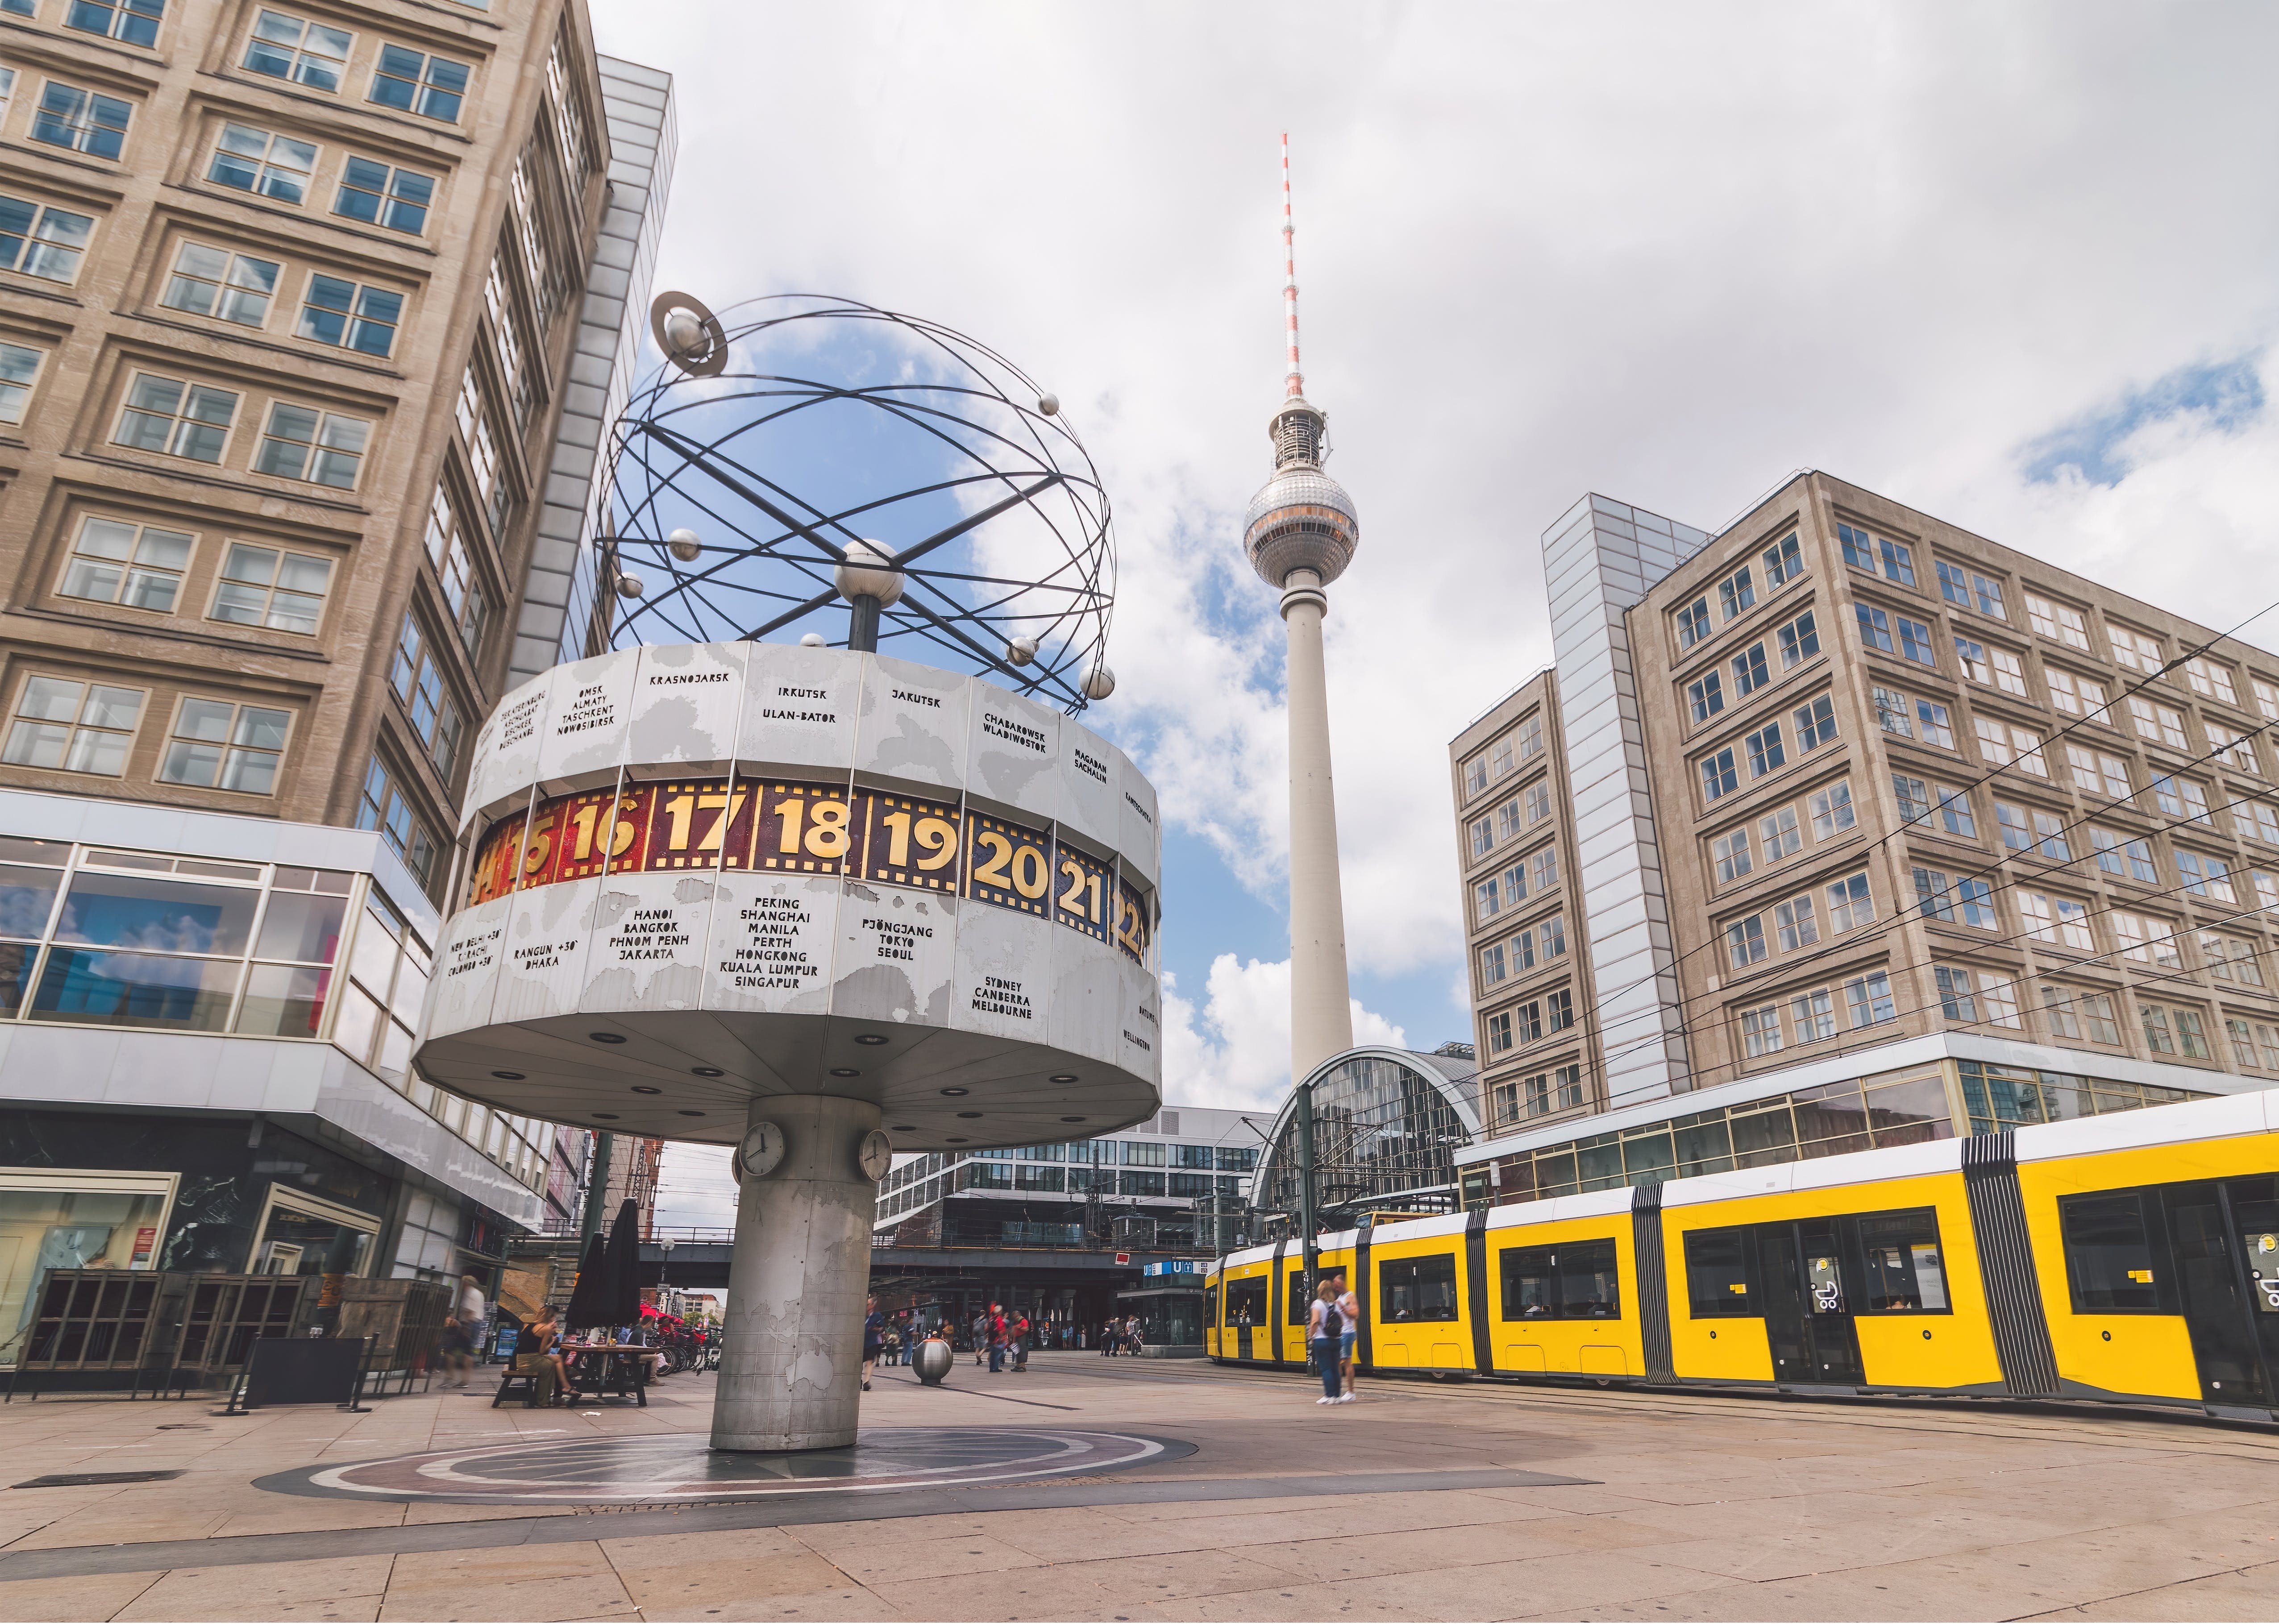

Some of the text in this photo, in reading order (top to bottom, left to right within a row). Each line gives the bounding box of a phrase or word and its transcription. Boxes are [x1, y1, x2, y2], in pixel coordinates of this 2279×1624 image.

[650, 673, 729, 685] KRASNOJARSK
[579, 685, 603, 698] OMSK
[778, 687, 827, 699] IRKUTSK
[892, 689, 941, 708] JAKUTSK
[572, 695, 607, 710] ALMATY
[563, 705, 614, 723] TASCHKENT
[763, 709, 836, 723] ULAN-BATOR
[557, 716, 615, 735] NOWOSIBIRSK
[984, 713, 1045, 743] CHABAROWSK
[983, 723, 1046, 754] WLADIWOSTOK
[1075, 748, 1106, 774] MAGADAN
[1074, 759, 1106, 784] SACHALIN
[1125, 792, 1152, 825] KAMTSCHATKA
[573, 799, 638, 860] 16
[665, 794, 746, 850] 17
[775, 799, 851, 858] 18
[509, 816, 554, 880] 15
[883, 811, 958, 870] 19
[974, 831, 1048, 899] 20
[1059, 860, 1101, 924] 21
[755, 897, 799, 909] PEKING
[634, 909, 673, 920] HANOI
[740, 910, 810, 922] SHANGHAI
[1111, 889, 1139, 955] 22
[624, 922, 678, 934] BANGKOK
[749, 923, 799, 935] MANILA
[862, 919, 932, 938] PJÖNGJANG
[466, 934, 486, 948] DELHI
[610, 935, 689, 947] PHNOM PENH
[753, 937, 792, 948] PERTH
[880, 934, 914, 948] TOKYO
[514, 944, 553, 959] RANGUN
[619, 949, 674, 960] JAKARTA
[736, 949, 807, 962] HONGKONG
[877, 947, 914, 960] SEOUL
[449, 960, 476, 976] COLOMBO
[526, 956, 559, 970] DHAKA
[720, 962, 818, 976] KUALA LUMPUR
[735, 976, 799, 989] SINGAPUR
[986, 976, 1022, 992] SYDNEY
[975, 987, 1030, 1006] CANBERRA
[972, 999, 1031, 1019] MELBOURNE
[1123, 1029, 1150, 1052] WELLINGTON
[1144, 1265, 1148, 1275] U
[1173, 1262, 1181, 1272] U
